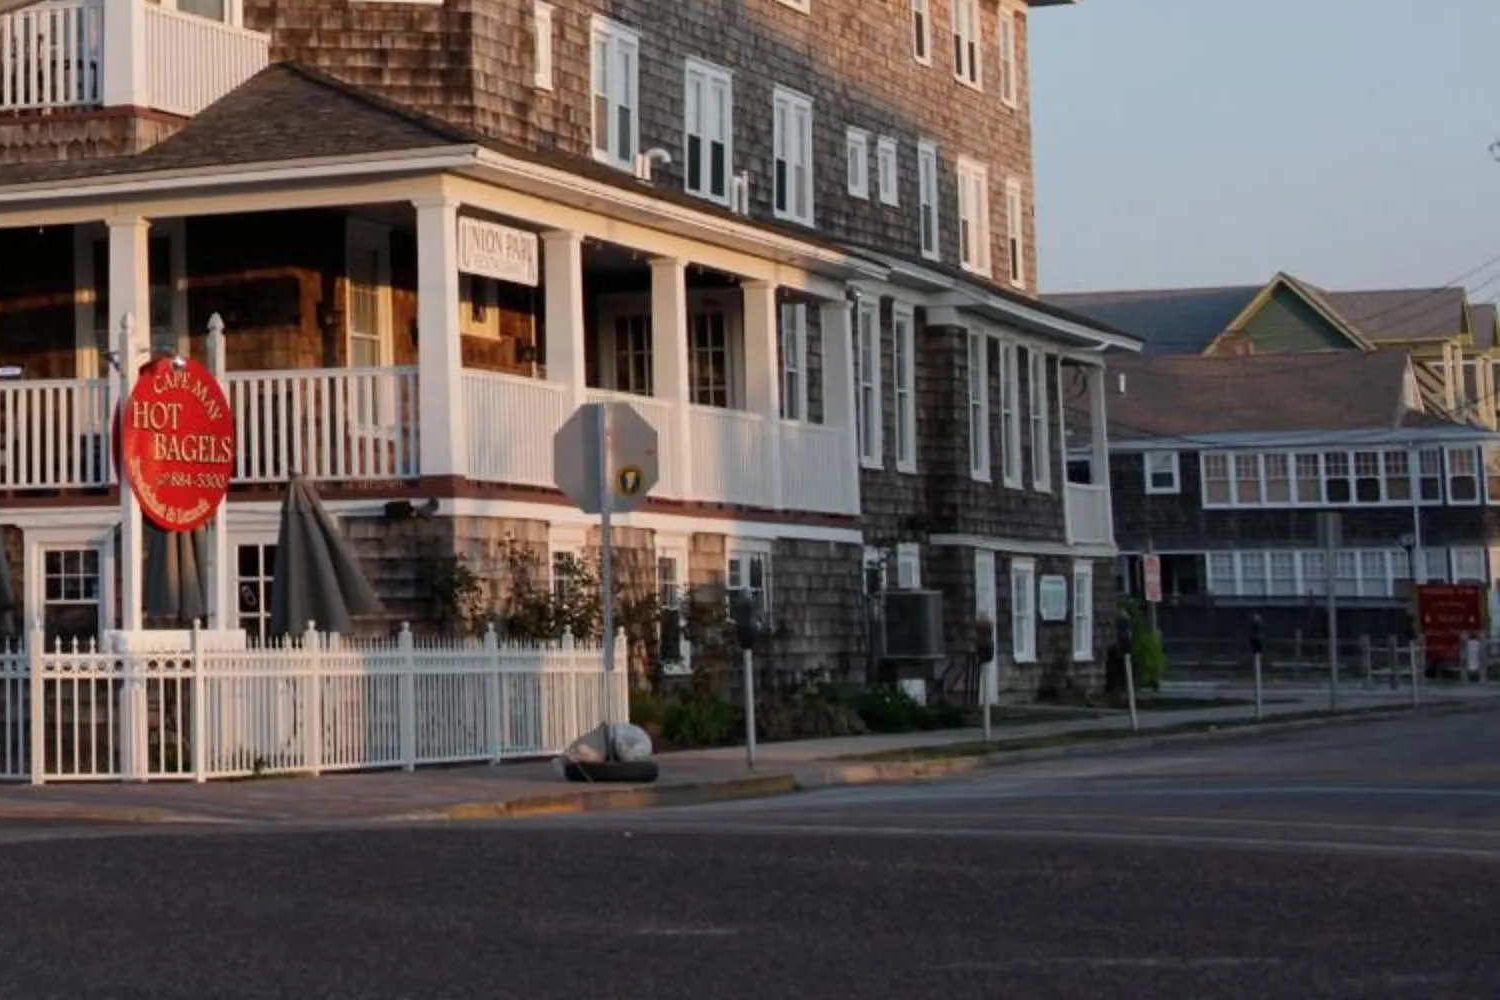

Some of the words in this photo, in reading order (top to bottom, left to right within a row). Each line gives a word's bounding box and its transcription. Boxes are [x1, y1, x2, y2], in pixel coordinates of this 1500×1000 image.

[153, 372, 191, 394] CAPE
[191, 380, 222, 420] MAY
[133, 401, 183, 430] HOT
[153, 433, 233, 463] BAGELS
